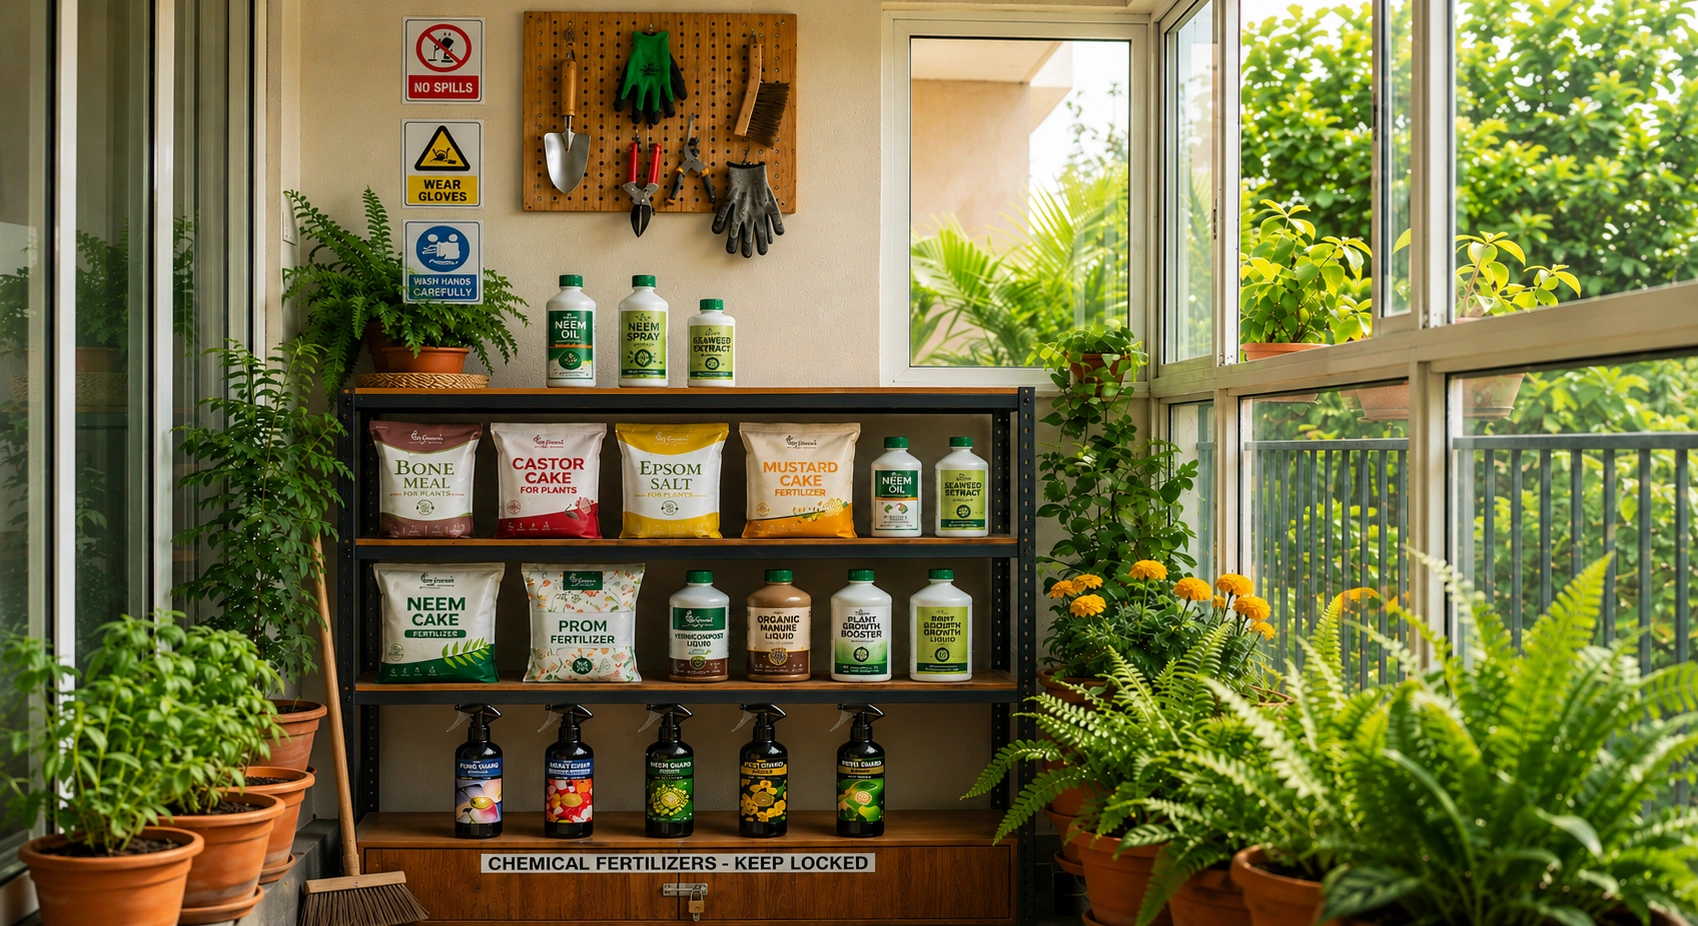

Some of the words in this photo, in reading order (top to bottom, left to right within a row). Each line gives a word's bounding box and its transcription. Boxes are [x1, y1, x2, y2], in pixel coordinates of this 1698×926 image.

[414, 82, 430, 93] NO
[434, 82, 473, 93] SPILLS
[423, 180, 461, 190] WEAR
[418, 191, 467, 202] GLOVES
[413, 277, 439, 285] WASH
[441, 277, 471, 285] HANDS
[413, 288, 472, 297] CAREFULLY
[555, 320, 586, 330] NEEM
[628, 322, 660, 331] NEEM
[561, 329, 580, 339] OIL
[627, 332, 660, 341] SPRAY
[395, 459, 455, 475] BONE
[512, 457, 584, 470] CASTOR
[640, 460, 702, 476] EPSOM
[763, 461, 839, 473] MUSTARD
[525, 471, 572, 484] CAKE
[779, 475, 822, 487] CAKE
[882, 476, 912, 485] NEEM
[403, 477, 450, 489] MEAL
[650, 478, 693, 490] SALT
[520, 486, 539, 494] FOR
[541, 486, 577, 494] PLANTS
[774, 488, 826, 496] FERTILIZER
[407, 597, 466, 611] NEEM
[411, 613, 459, 626] CAKE
[757, 615, 800, 624] ORGANIC
[847, 615, 877, 623] PLANT
[558, 620, 607, 632] PROM
[550, 635, 615, 644] FERTILIZER
[765, 632, 794, 640] LIQUID
[488, 856, 589, 871] CHEMICAL
[596, 856, 717, 871] FERTILIZERS
[734, 856, 784, 871] KEEP
[790, 856, 869, 871] LOCKED
